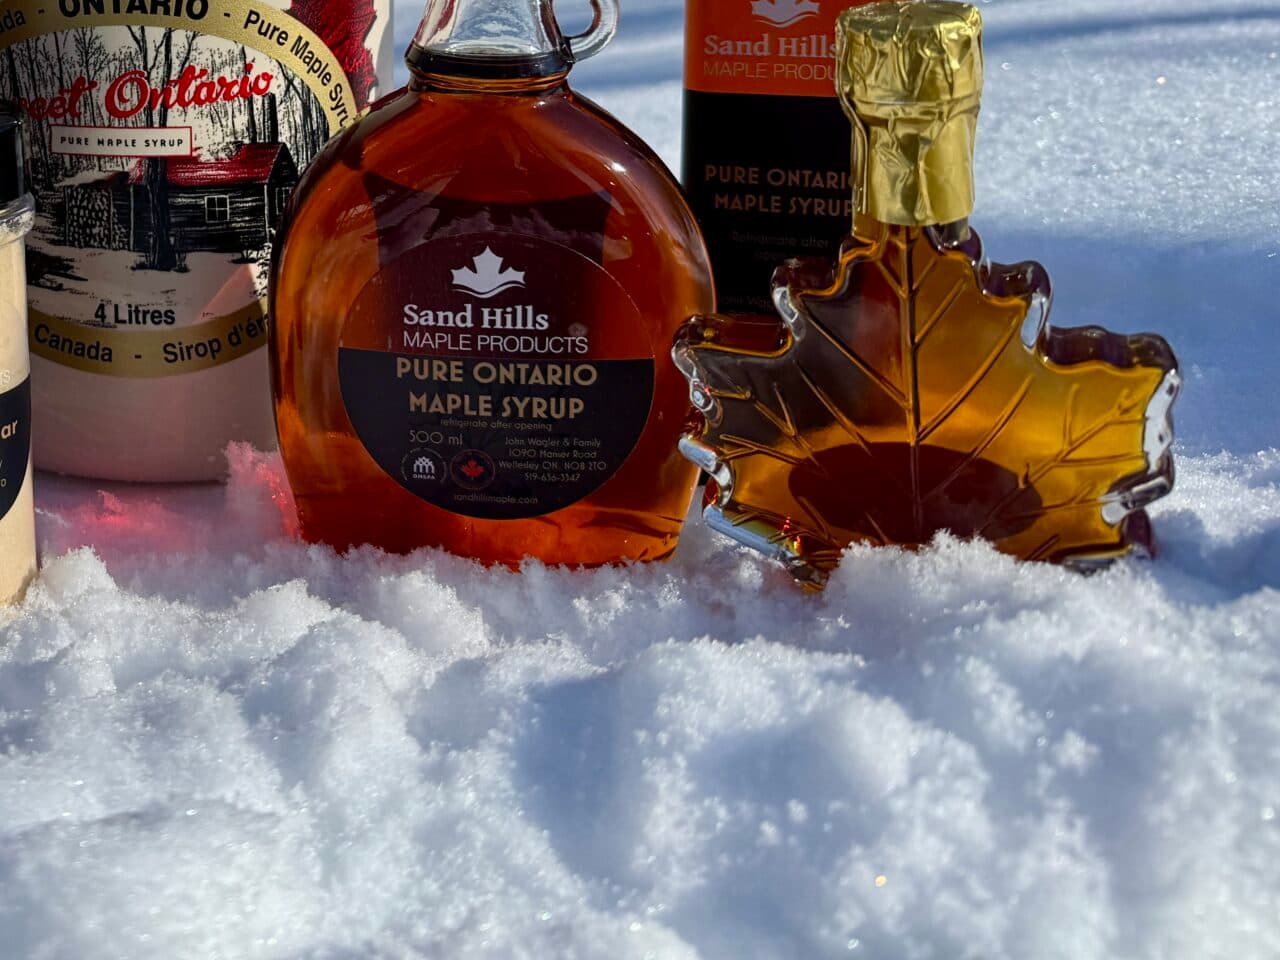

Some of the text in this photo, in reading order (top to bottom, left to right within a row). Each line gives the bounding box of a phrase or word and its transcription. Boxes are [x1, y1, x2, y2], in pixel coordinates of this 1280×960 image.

[243, 9, 289, 46] Pure
[290, 35, 332, 87] Maple
[704, 33, 771, 56] Sand
[704, 61, 769, 79] MAPLE
[105, 62, 273, 119] Ontario
[60, 136, 183, 147] PURE MAPLE SYRUP
[704, 164, 760, 185] PURE
[714, 193, 783, 213] MAPLE
[94, 303, 176, 325] 4 Litres
[403, 303, 549, 330] Sand Hills
[35, 324, 222, 363] Canada Sirop
[403, 331, 588, 354] MAPLE PRODUCTS
[396, 357, 598, 386] PURE ONTARIO
[409, 391, 585, 419] MAPLE SYRUP
[409, 429, 444, 444] 500
